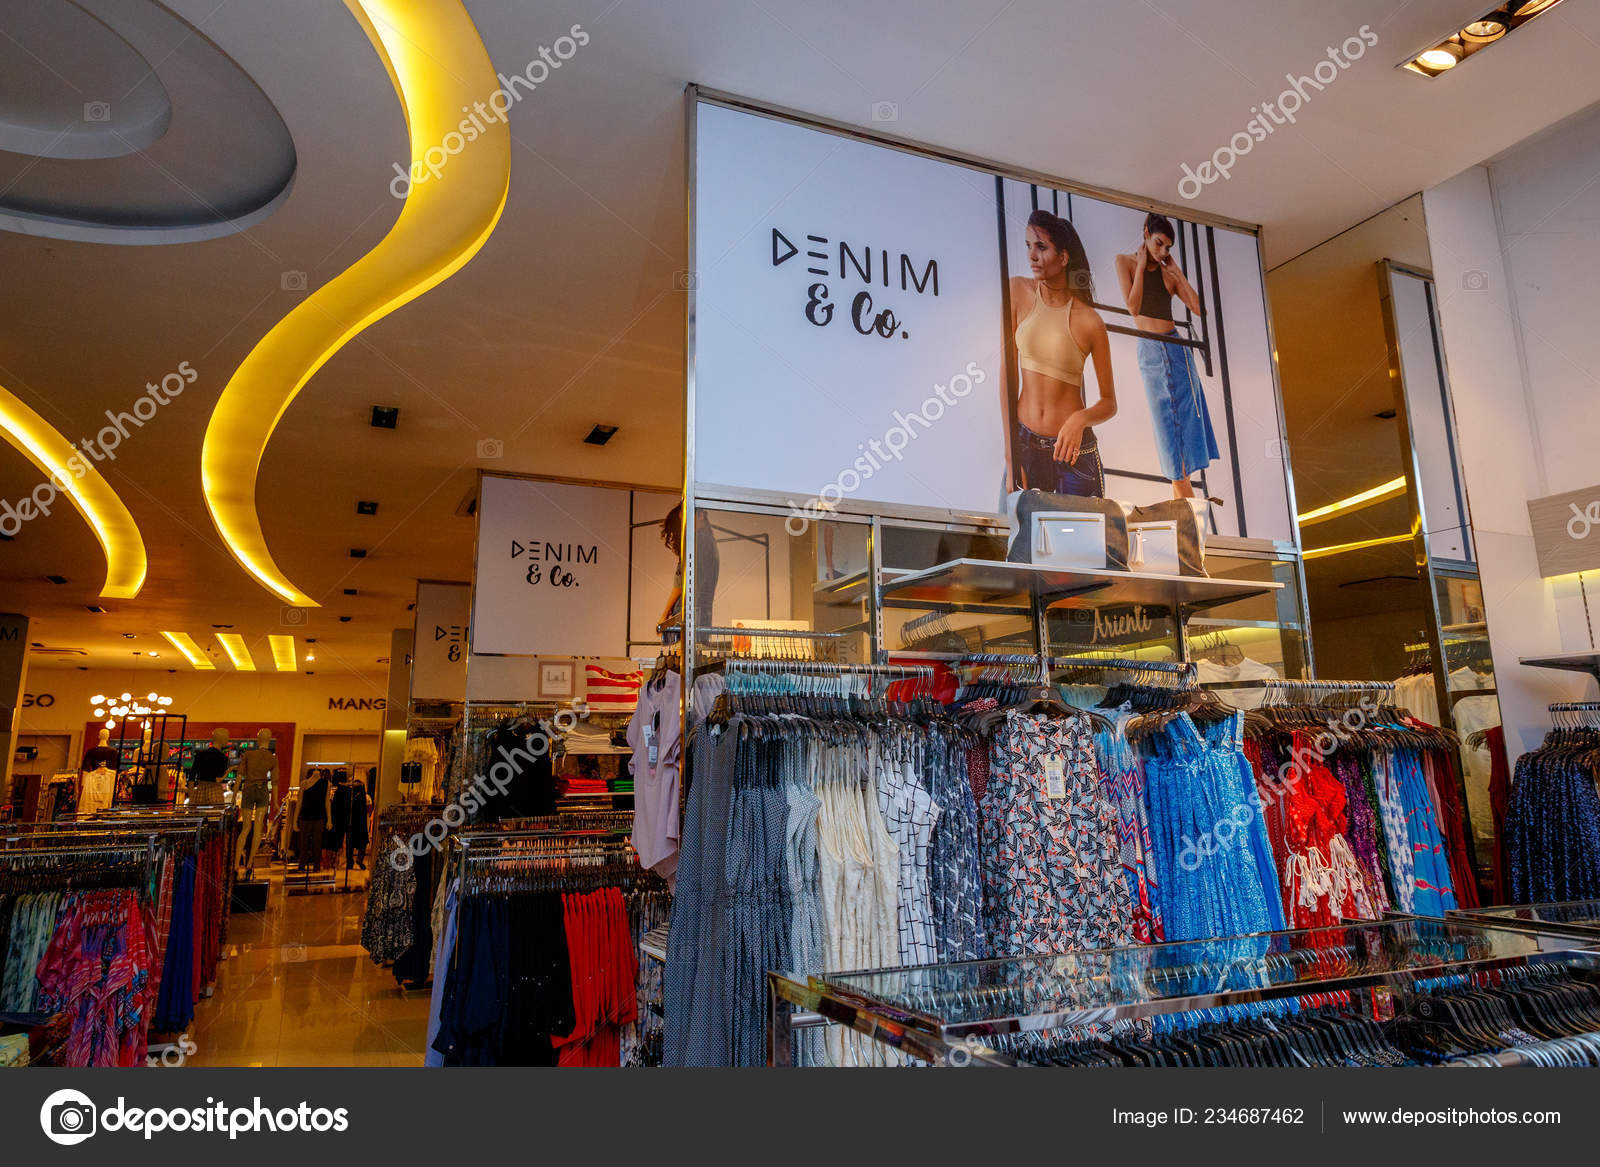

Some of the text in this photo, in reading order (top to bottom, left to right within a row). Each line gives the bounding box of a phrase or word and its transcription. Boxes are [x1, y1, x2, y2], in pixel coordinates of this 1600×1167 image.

[772, 228, 938, 296] DENIM
[805, 283, 908, 339] & Co.
[512, 540, 598, 564] DENIM
[526, 564, 579, 587] & Co.
[448, 644, 461, 662] &
